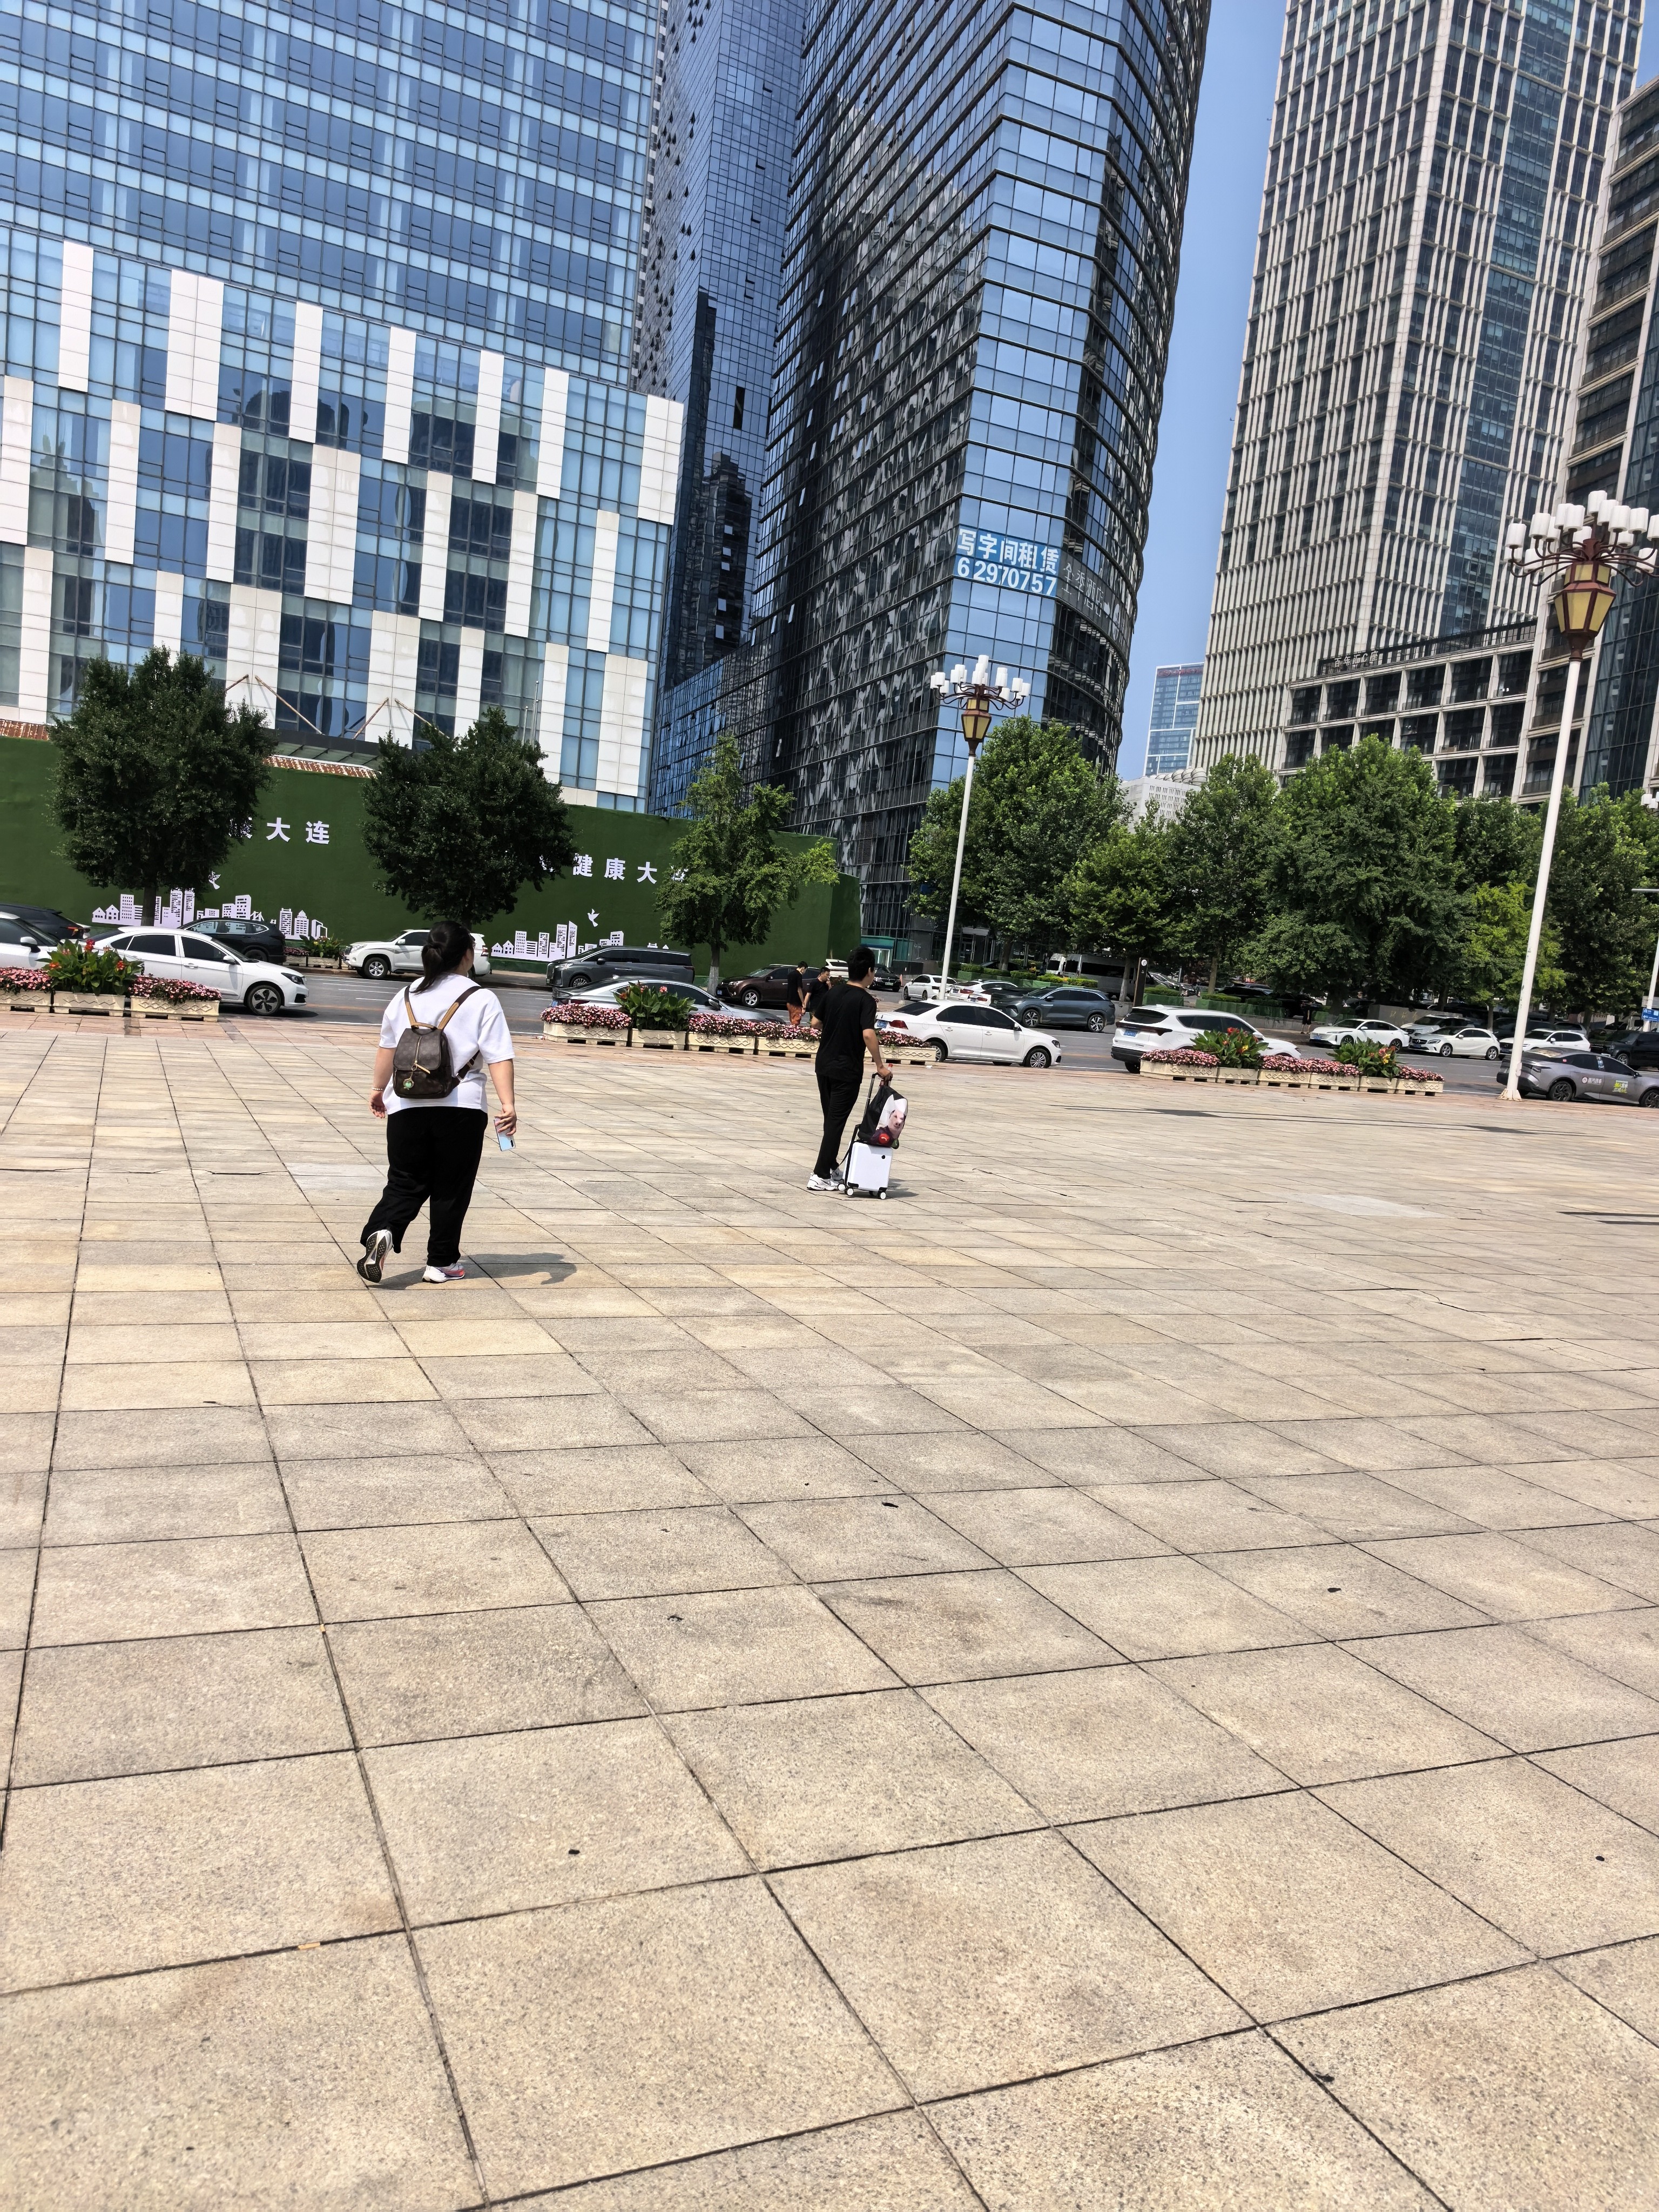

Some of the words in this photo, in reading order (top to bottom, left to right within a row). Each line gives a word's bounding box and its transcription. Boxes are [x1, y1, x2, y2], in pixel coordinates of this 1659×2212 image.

[957, 528, 1059, 575] 写字间租赁
[957, 557, 1057, 596] 62970757
[1062, 563, 1103, 617] 全季酒店
[1334, 650, 1378, 668] 百年汇C座
